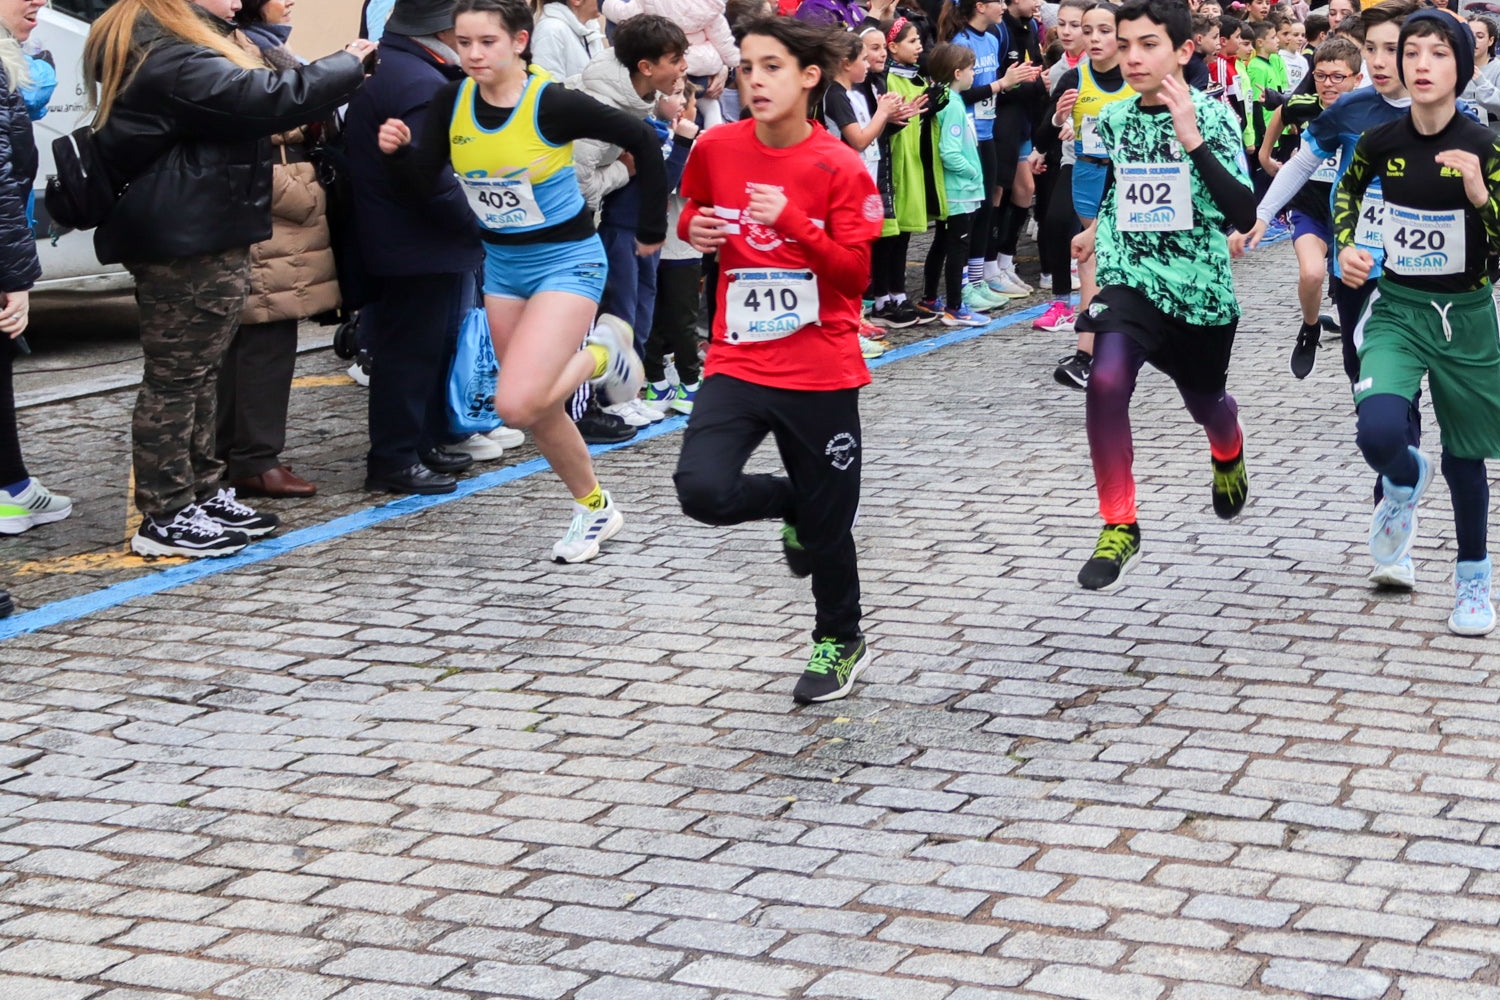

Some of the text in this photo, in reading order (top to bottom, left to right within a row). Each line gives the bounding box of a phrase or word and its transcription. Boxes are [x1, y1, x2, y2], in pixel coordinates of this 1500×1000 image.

[478, 190, 521, 209] 403
[1126, 183, 1172, 205] 402
[484, 212, 523, 223] HESAN
[1130, 212, 1171, 223] HESAN
[1393, 226, 1445, 251] 420
[1397, 255, 1443, 267] HESAN
[743, 288, 798, 312] 410
[747, 318, 797, 333] HESAN
